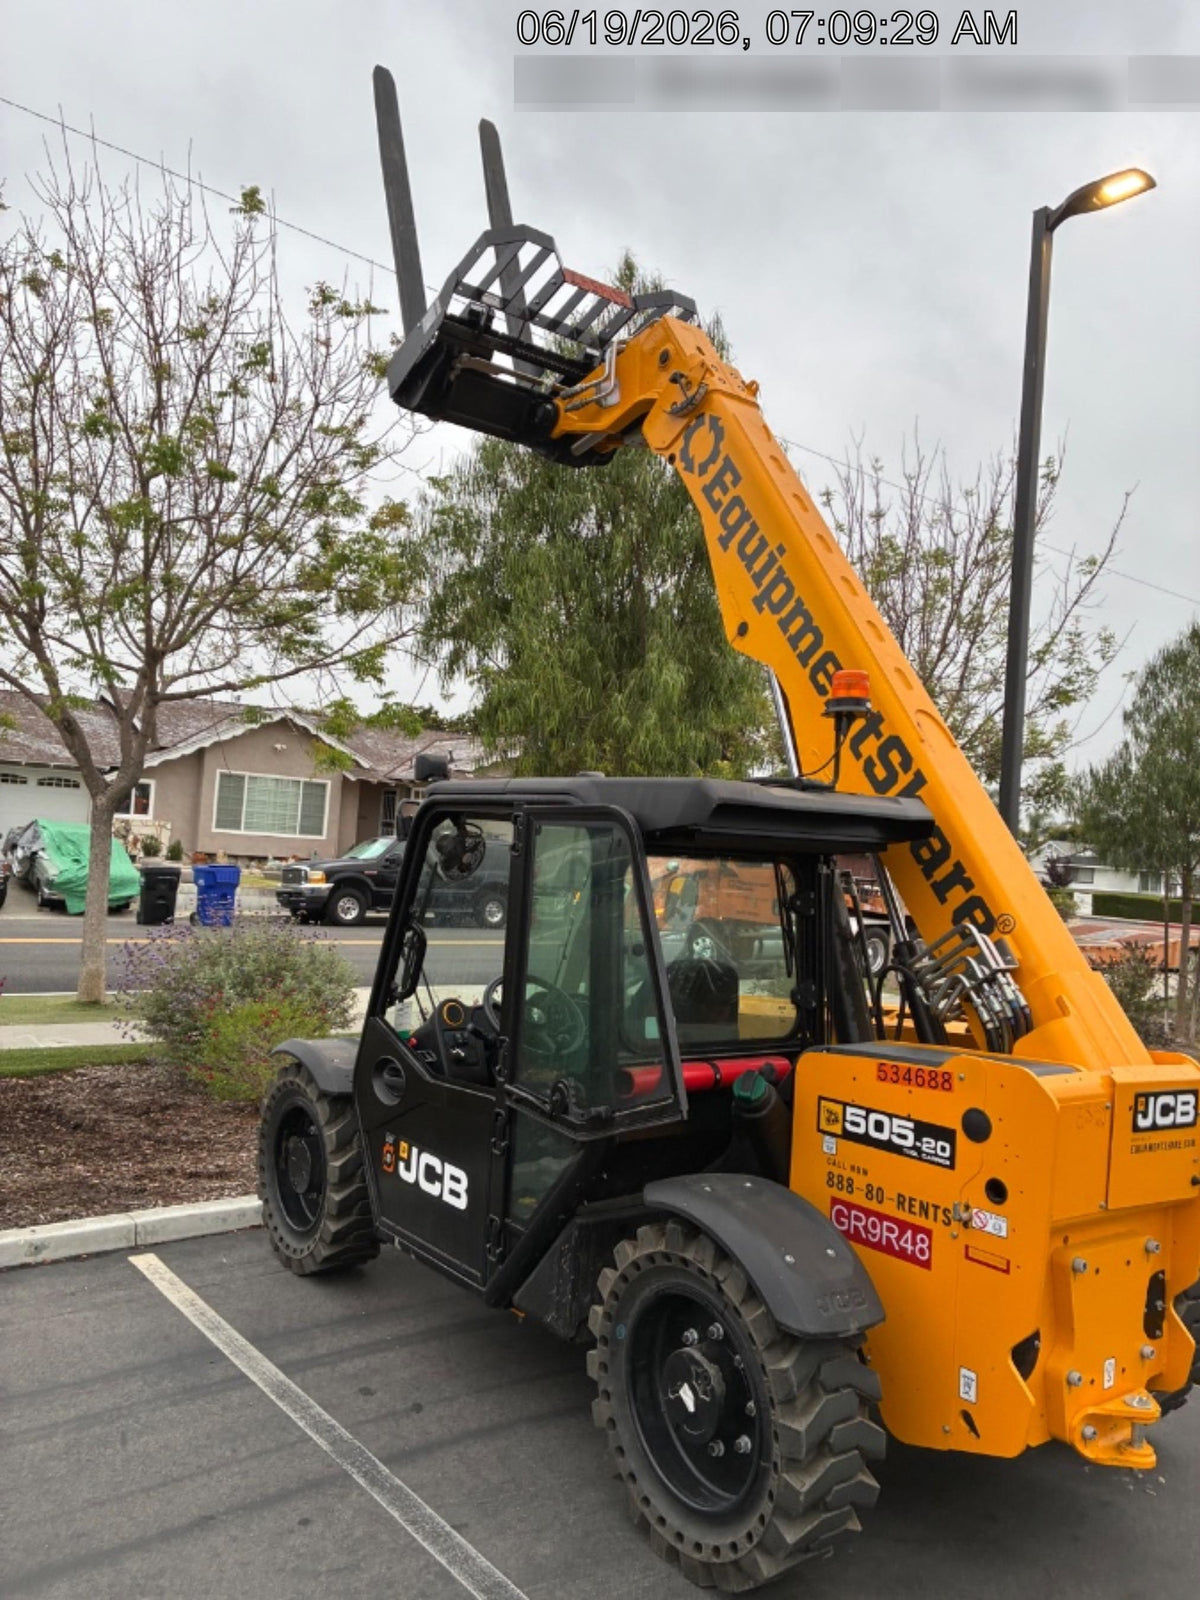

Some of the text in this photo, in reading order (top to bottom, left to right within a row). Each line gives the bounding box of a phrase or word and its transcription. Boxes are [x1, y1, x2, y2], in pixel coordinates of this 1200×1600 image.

[877, 1063, 953, 1091] 534688
[1137, 1093, 1196, 1128] JCB
[398, 1146, 468, 1210] JCB
[831, 1204, 930, 1261] GR9R48
